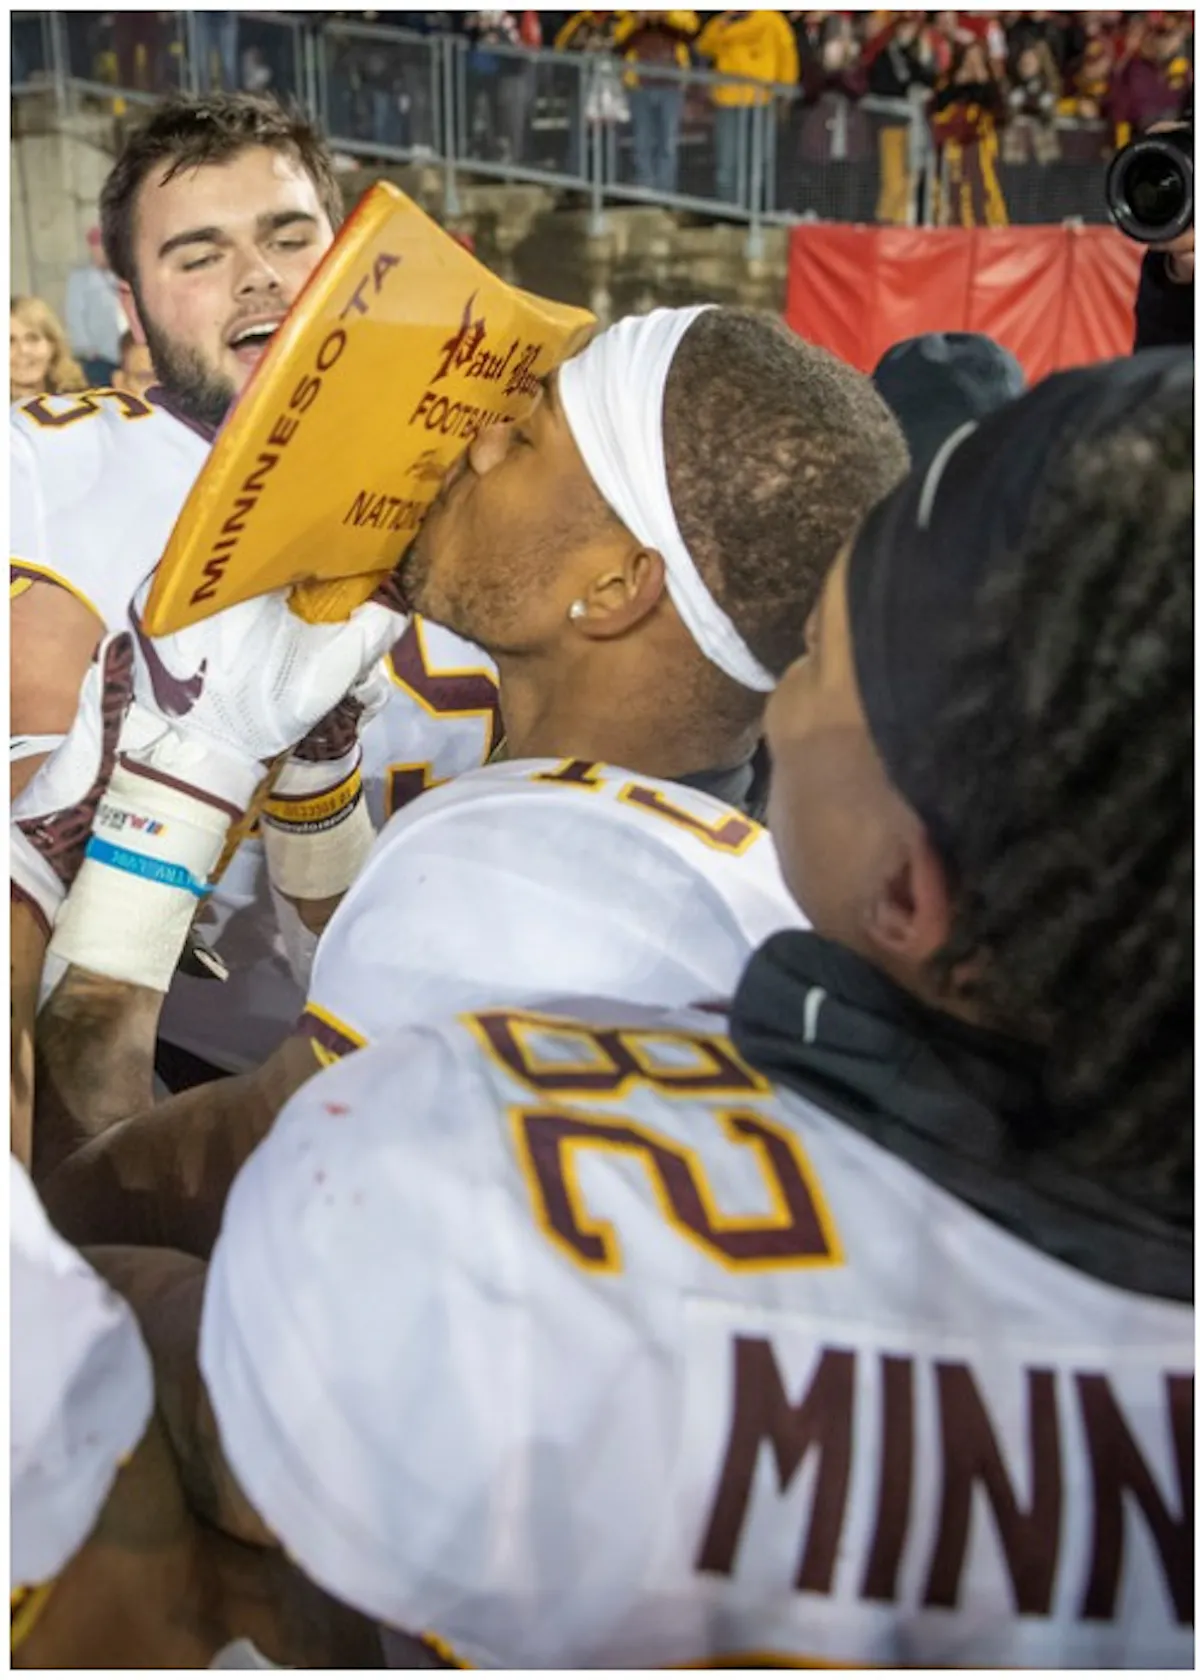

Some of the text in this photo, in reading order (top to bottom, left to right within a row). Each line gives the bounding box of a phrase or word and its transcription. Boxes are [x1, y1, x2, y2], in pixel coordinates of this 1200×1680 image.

[190, 252, 402, 607] MINNESOTA
[429, 288, 521, 385] Paul
[457, 1006, 846, 1275] 82
[694, 1333, 1195, 1633] MINN
